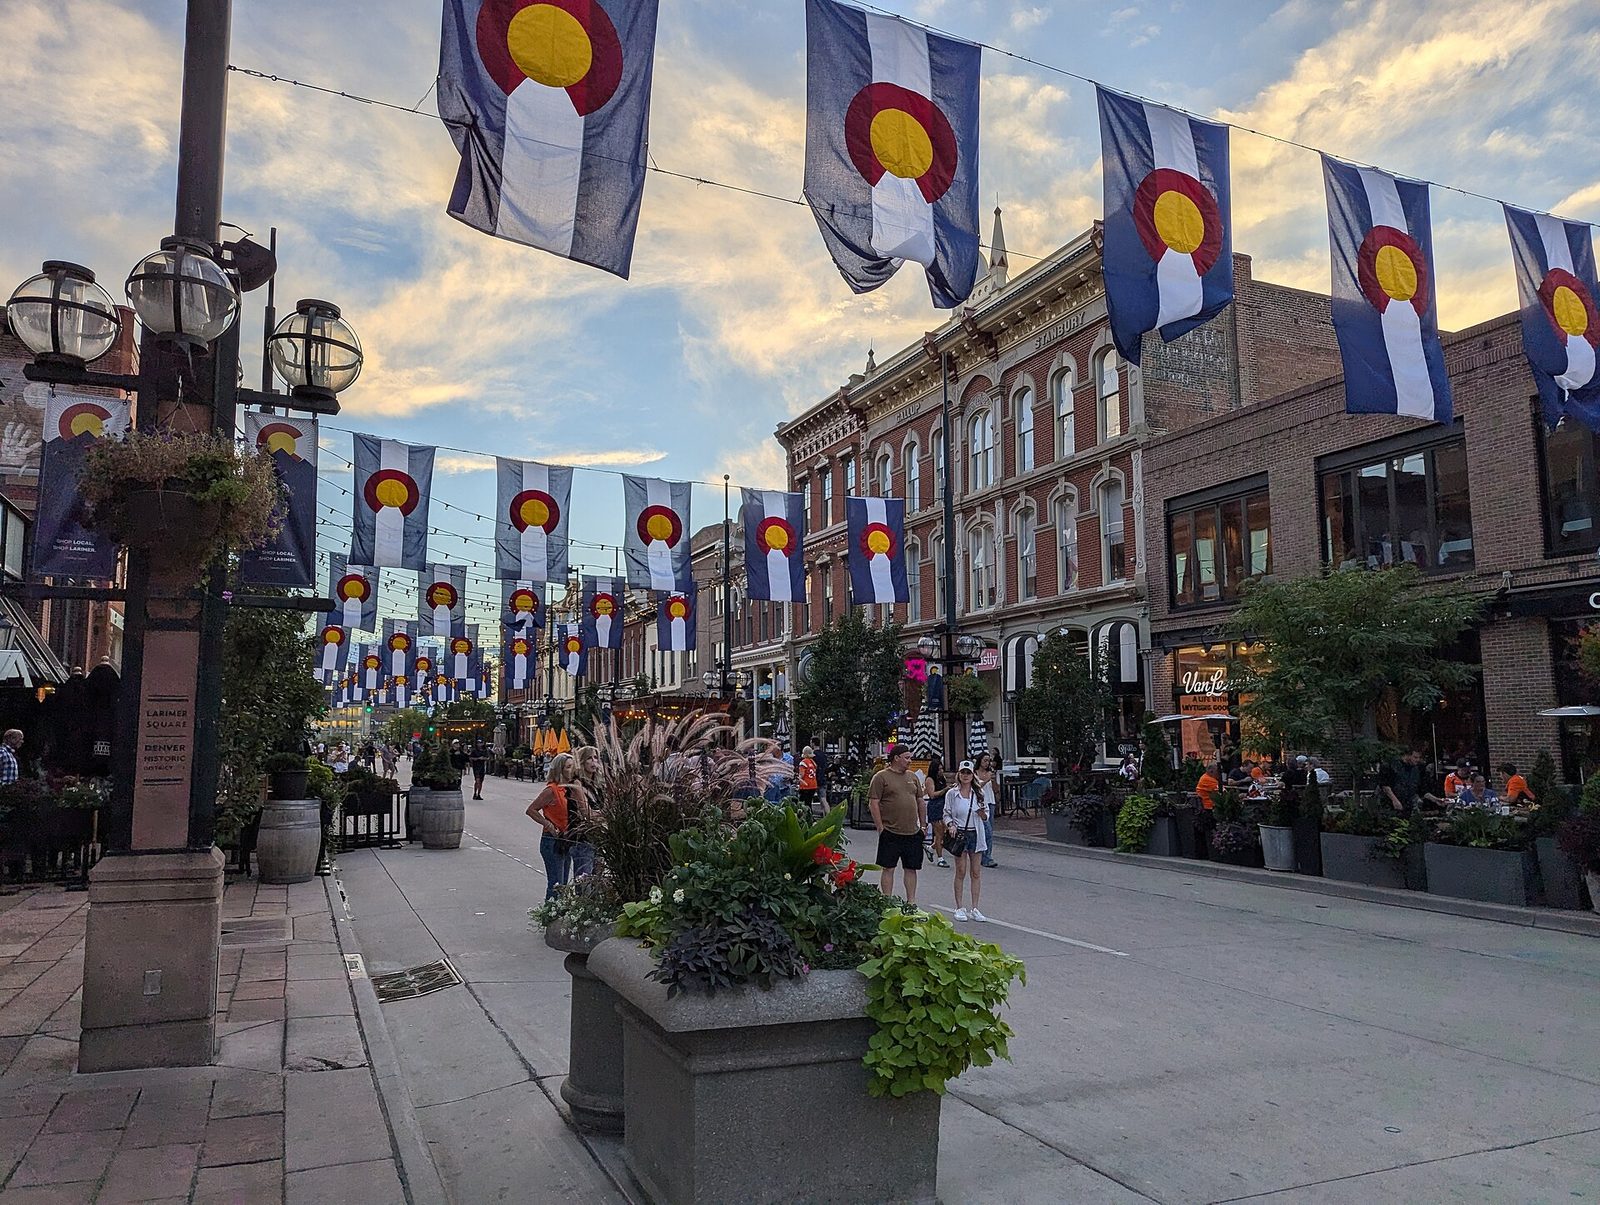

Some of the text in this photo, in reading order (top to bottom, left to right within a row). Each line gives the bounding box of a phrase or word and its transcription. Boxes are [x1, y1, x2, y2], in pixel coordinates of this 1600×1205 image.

[1034, 311, 1086, 350] STANBURY
[896, 402, 920, 422] GALLUP
[1182, 671, 1211, 693] Van
[146, 710, 188, 718] LARIMER
[146, 721, 187, 729] SQUARE
[144, 744, 186, 752] DENVER
